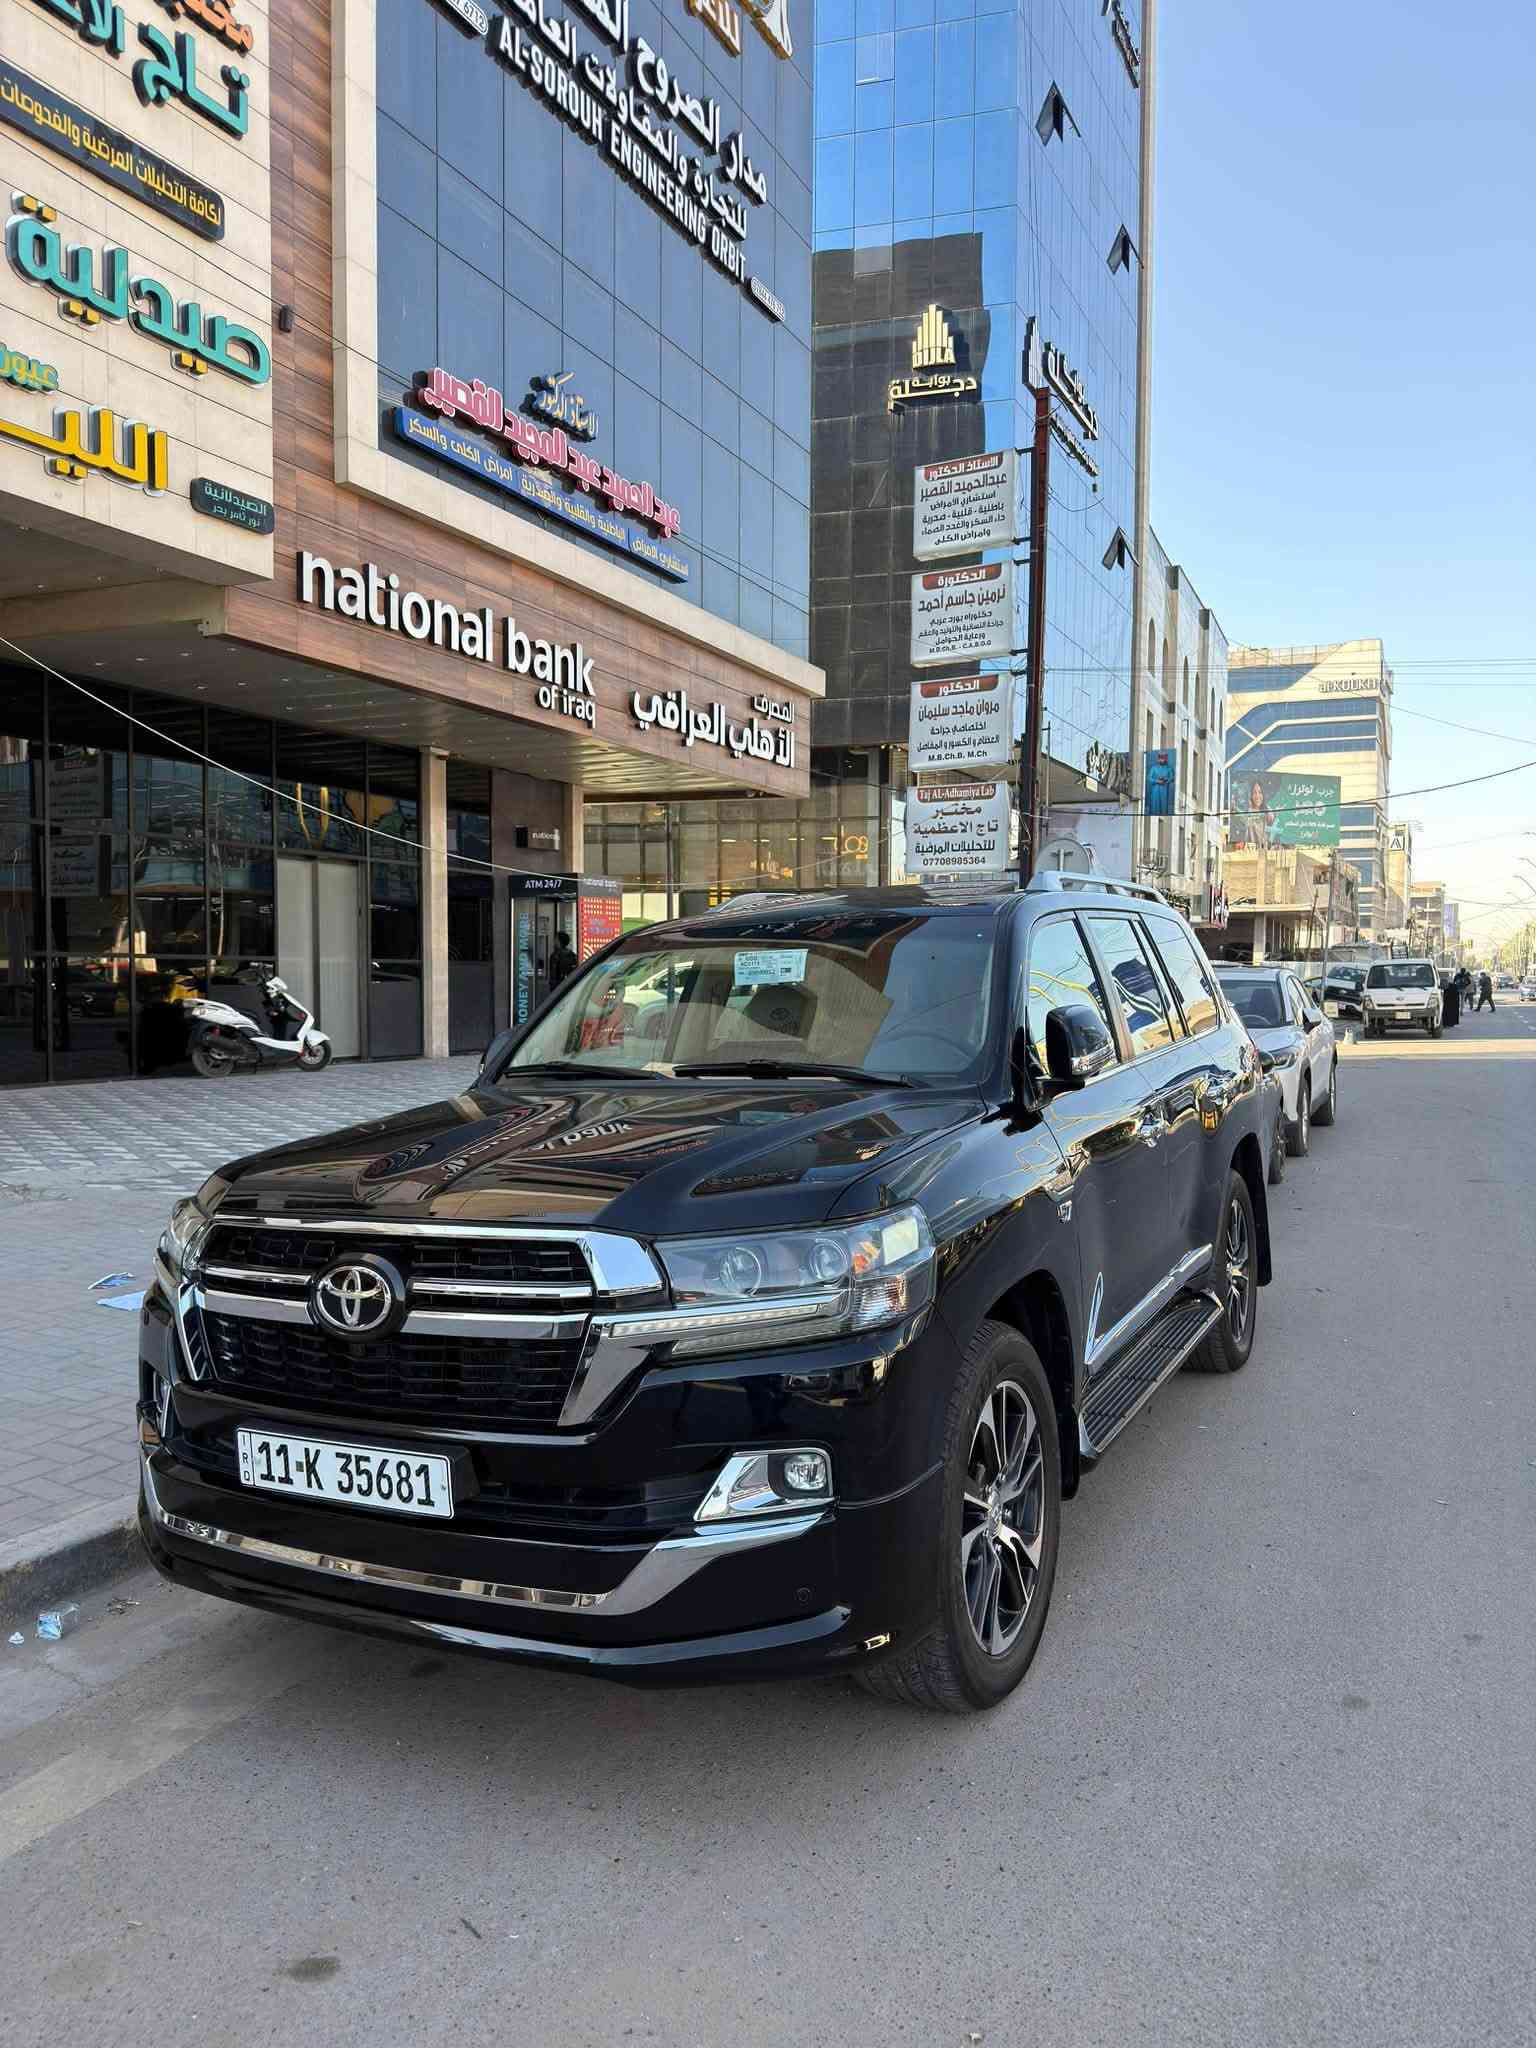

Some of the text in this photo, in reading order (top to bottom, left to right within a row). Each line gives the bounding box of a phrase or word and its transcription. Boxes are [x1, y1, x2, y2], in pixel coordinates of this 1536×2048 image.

[637, 36, 721, 154] الصروح
[585, 53, 687, 185] والمقاولات
[83, 127, 134, 175] المرضية
[499, 16, 603, 141] AL-SOROUH
[611, 120, 707, 244] ENGINEERING
[711, 225, 747, 282] ORBIT
[725, 131, 767, 203] مدار
[136, 159, 187, 207] التحليلات
[694, 157, 747, 240] للتجارة
[14, 193, 272, 386] صيدلية
[888, 377, 977, 400] دجلة
[204, 482, 267, 516] الصيدلانية
[920, 480, 952, 503] القصير
[970, 515, 993, 528] السكر
[937, 568, 986, 588] الدكتورة
[945, 589, 976, 612] جاسم
[977, 583, 1006, 606] نرمين
[300, 551, 596, 696] national bank
[938, 679, 980, 697] الدكتور
[538, 682, 597, 729] of iraq
[633, 690, 726, 748] العراقي
[753, 695, 795, 724] المصرف
[918, 699, 1000, 722] مروان ماجد سليمان
[981, 785, 995, 796] Lab
[931, 803, 982, 820] مختبر
[976, 817, 999, 837] تاج
[914, 839, 996, 857] للتحليلات المرضية
[525, 879, 563, 889] ATM 24/7
[335, 1451, 436, 1508] 35681
